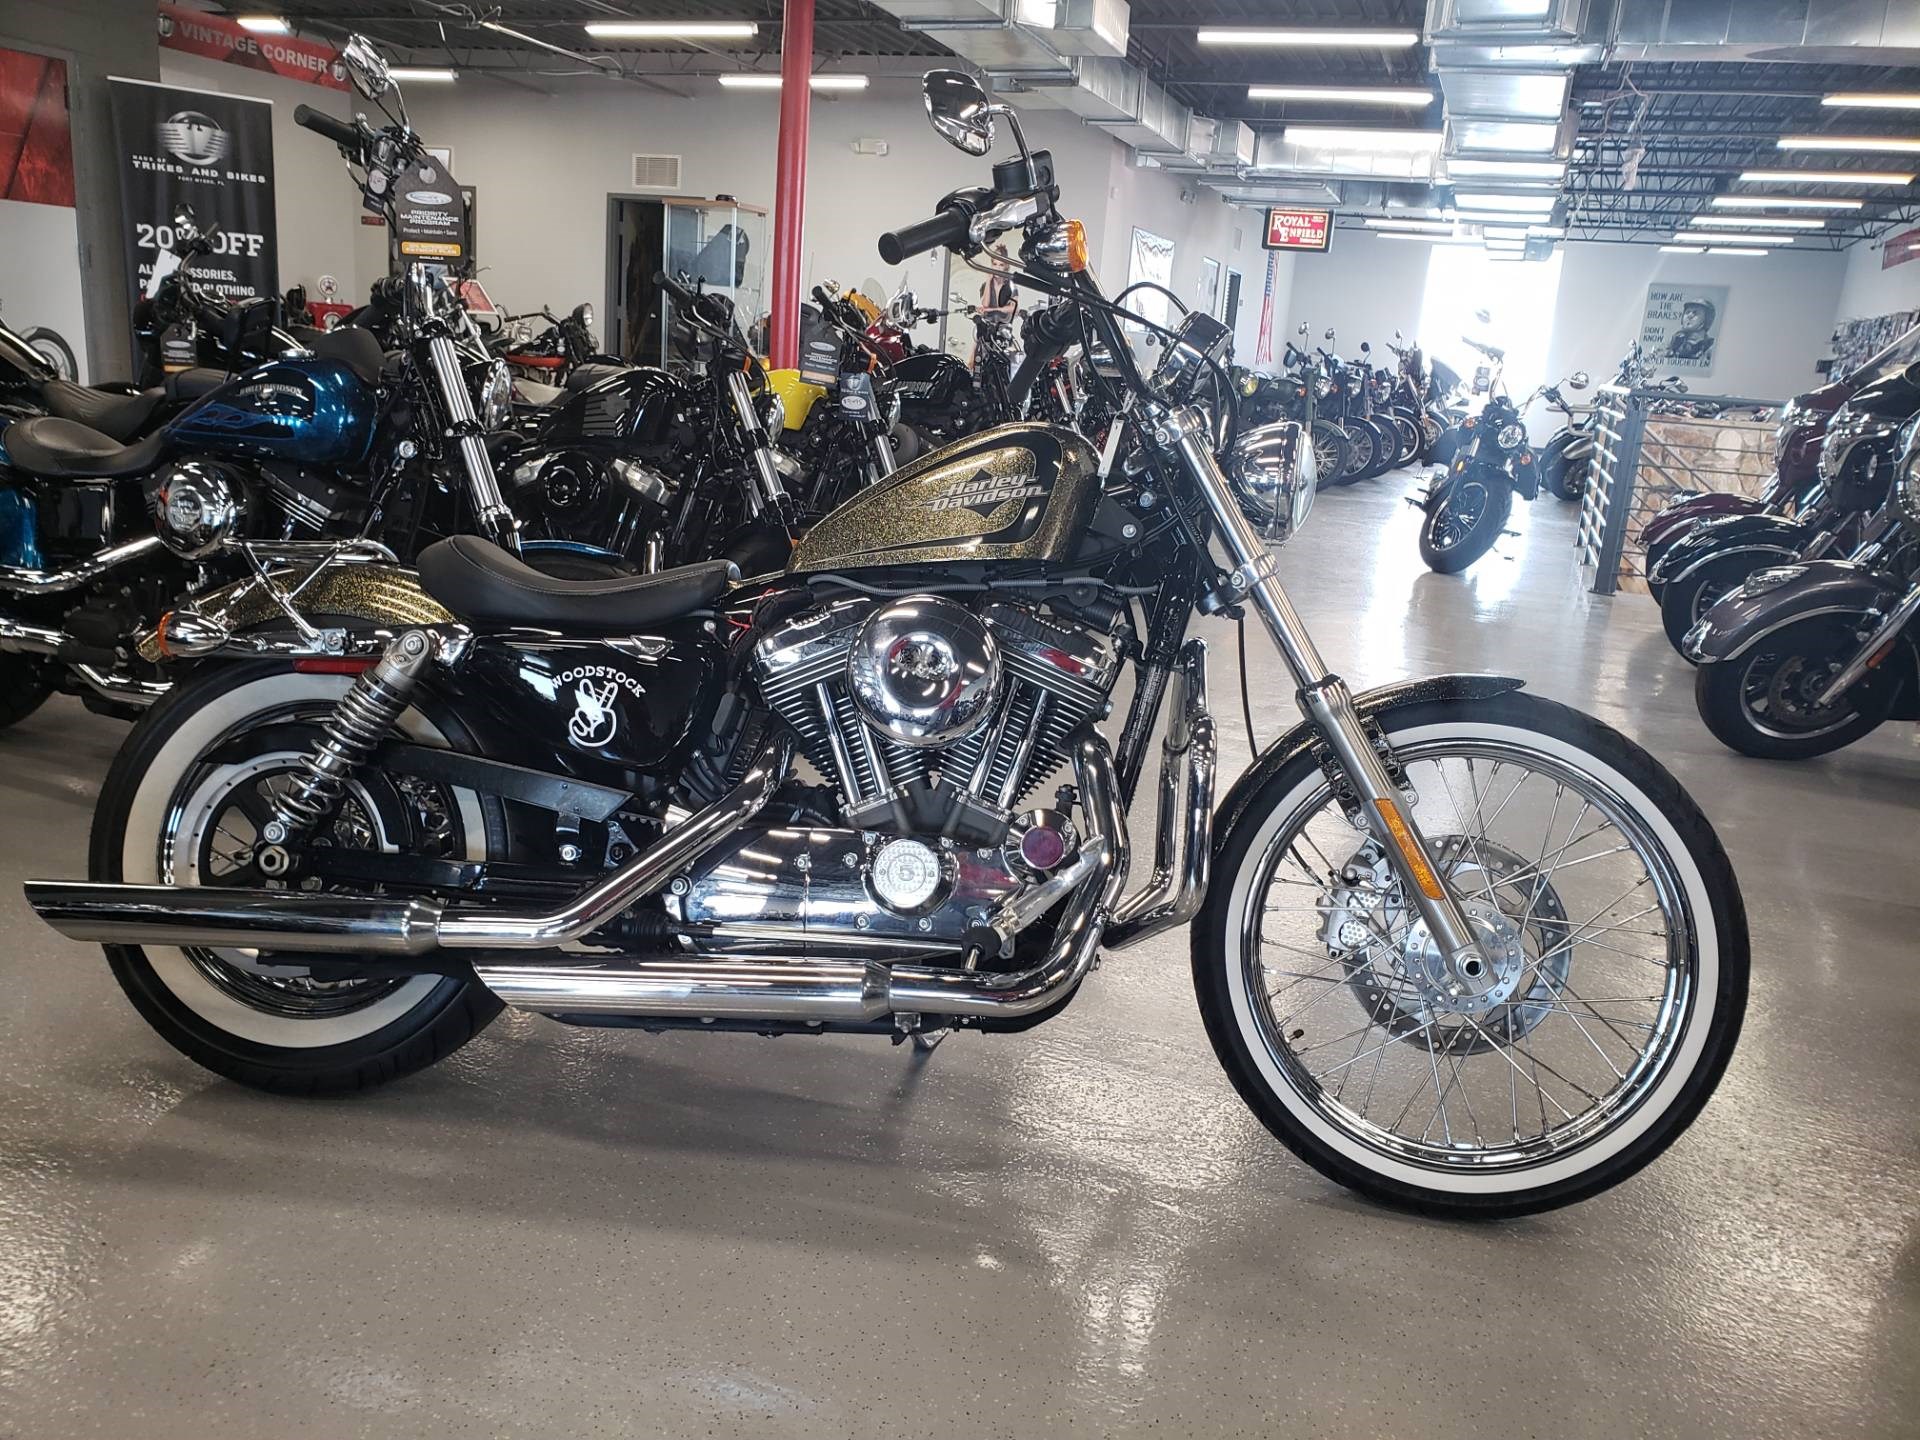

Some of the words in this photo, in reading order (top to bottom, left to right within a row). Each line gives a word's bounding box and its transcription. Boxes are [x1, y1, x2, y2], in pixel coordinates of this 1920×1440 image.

[180, 21, 258, 55] VINTAGE
[262, 43, 328, 74] CORNER
[132, 160, 183, 174] TRIKES
[191, 167, 219, 178] AND
[226, 171, 266, 184] BIKES
[400, 213, 459, 222] MAINTENANCE
[1272, 215, 1311, 230] ROYAL
[1280, 227, 1324, 242] ENFIELD
[189, 267, 237, 282] SSORIES,
[202, 283, 255, 297] COTHING
[1650, 292, 1668, 301] HOW
[1643, 334, 1665, 343] KNOW
[926, 486, 1048, 512] Davidson
[551, 665, 647, 699] WOODSTOCK
